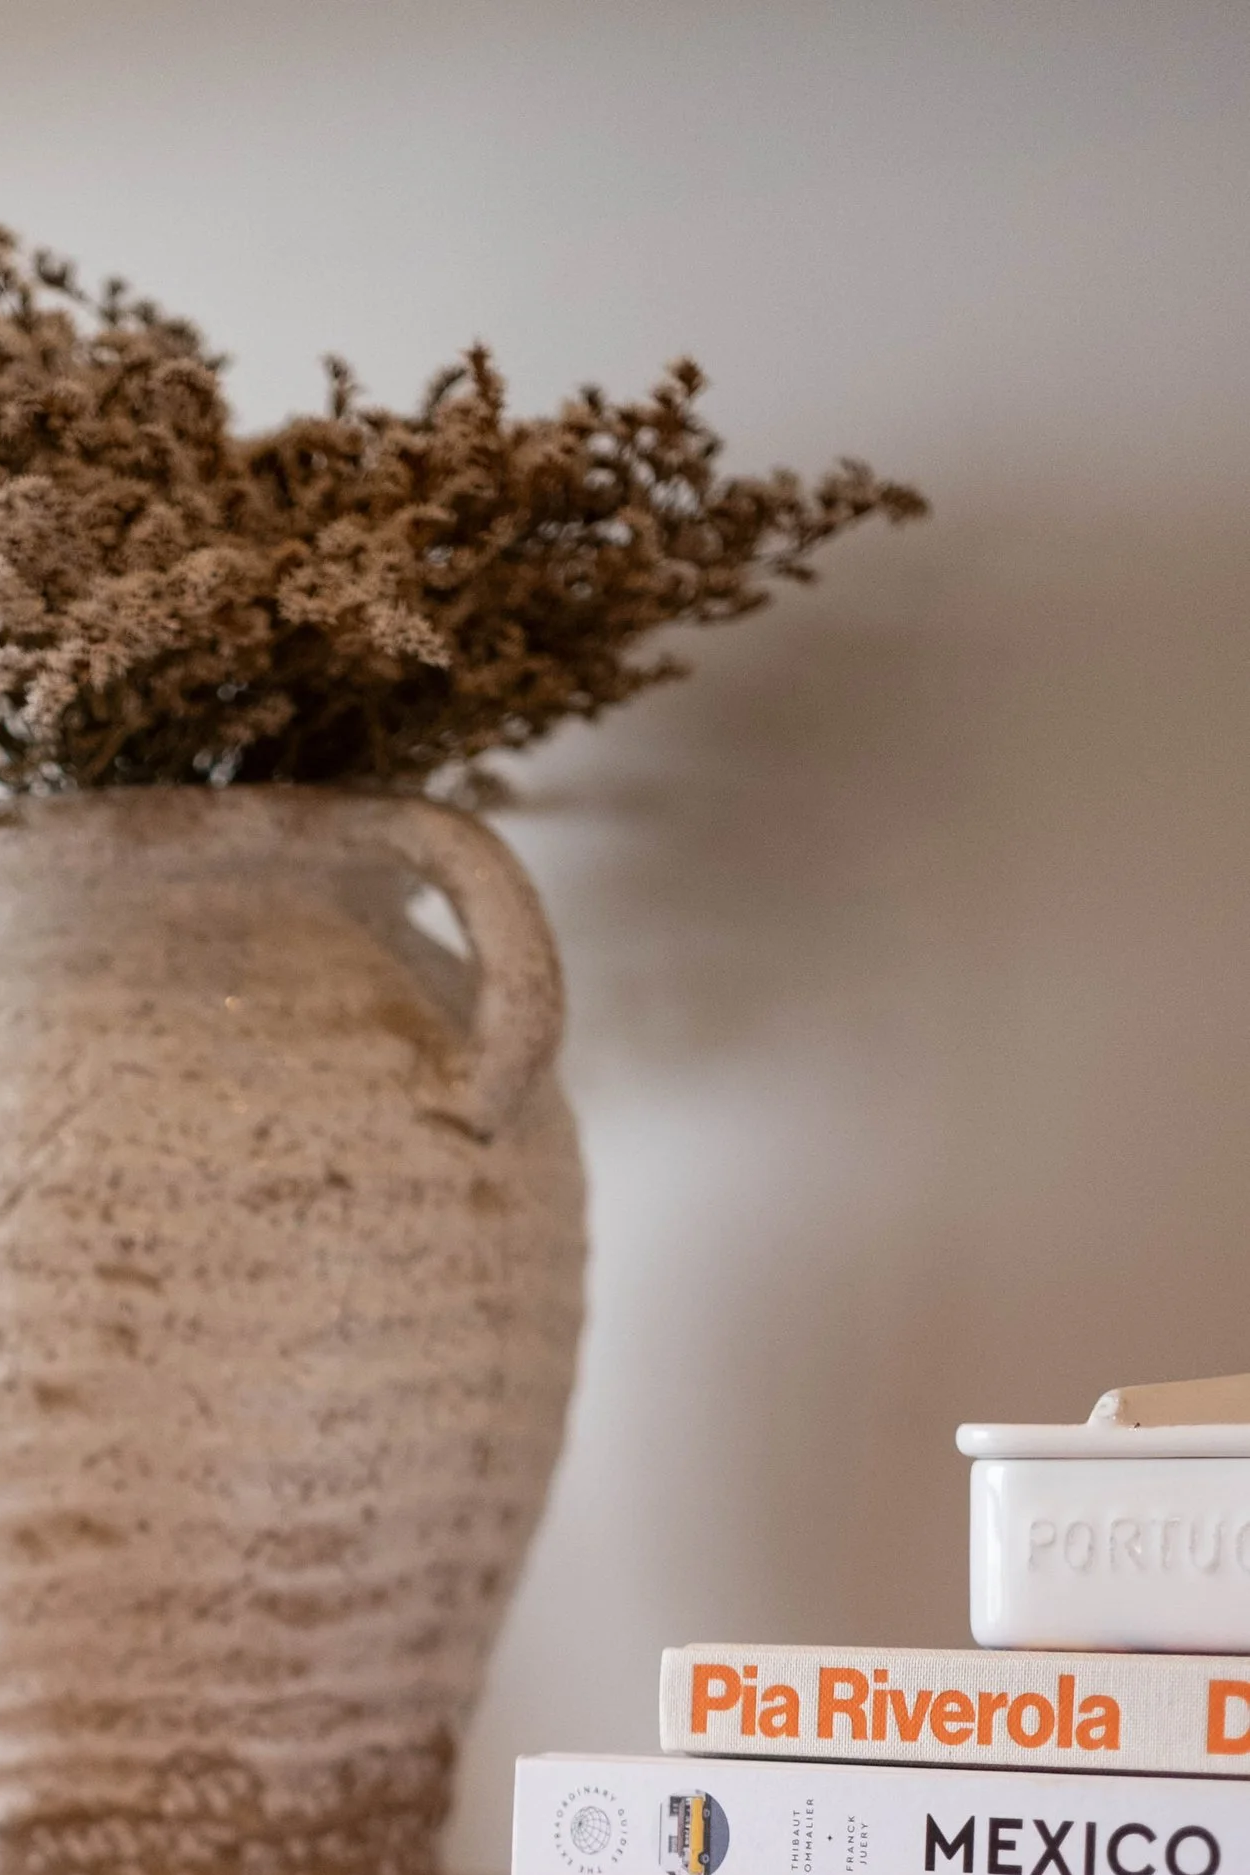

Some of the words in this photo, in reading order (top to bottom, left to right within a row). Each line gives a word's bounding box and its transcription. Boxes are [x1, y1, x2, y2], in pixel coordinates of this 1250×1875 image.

[691, 1663, 799, 1738] Pia
[817, 1667, 1121, 1750] Riverola
[791, 1810, 800, 1870] THIBAUT
[846, 1815, 855, 1872] FRANCK
[860, 1823, 868, 1865] JUERY
